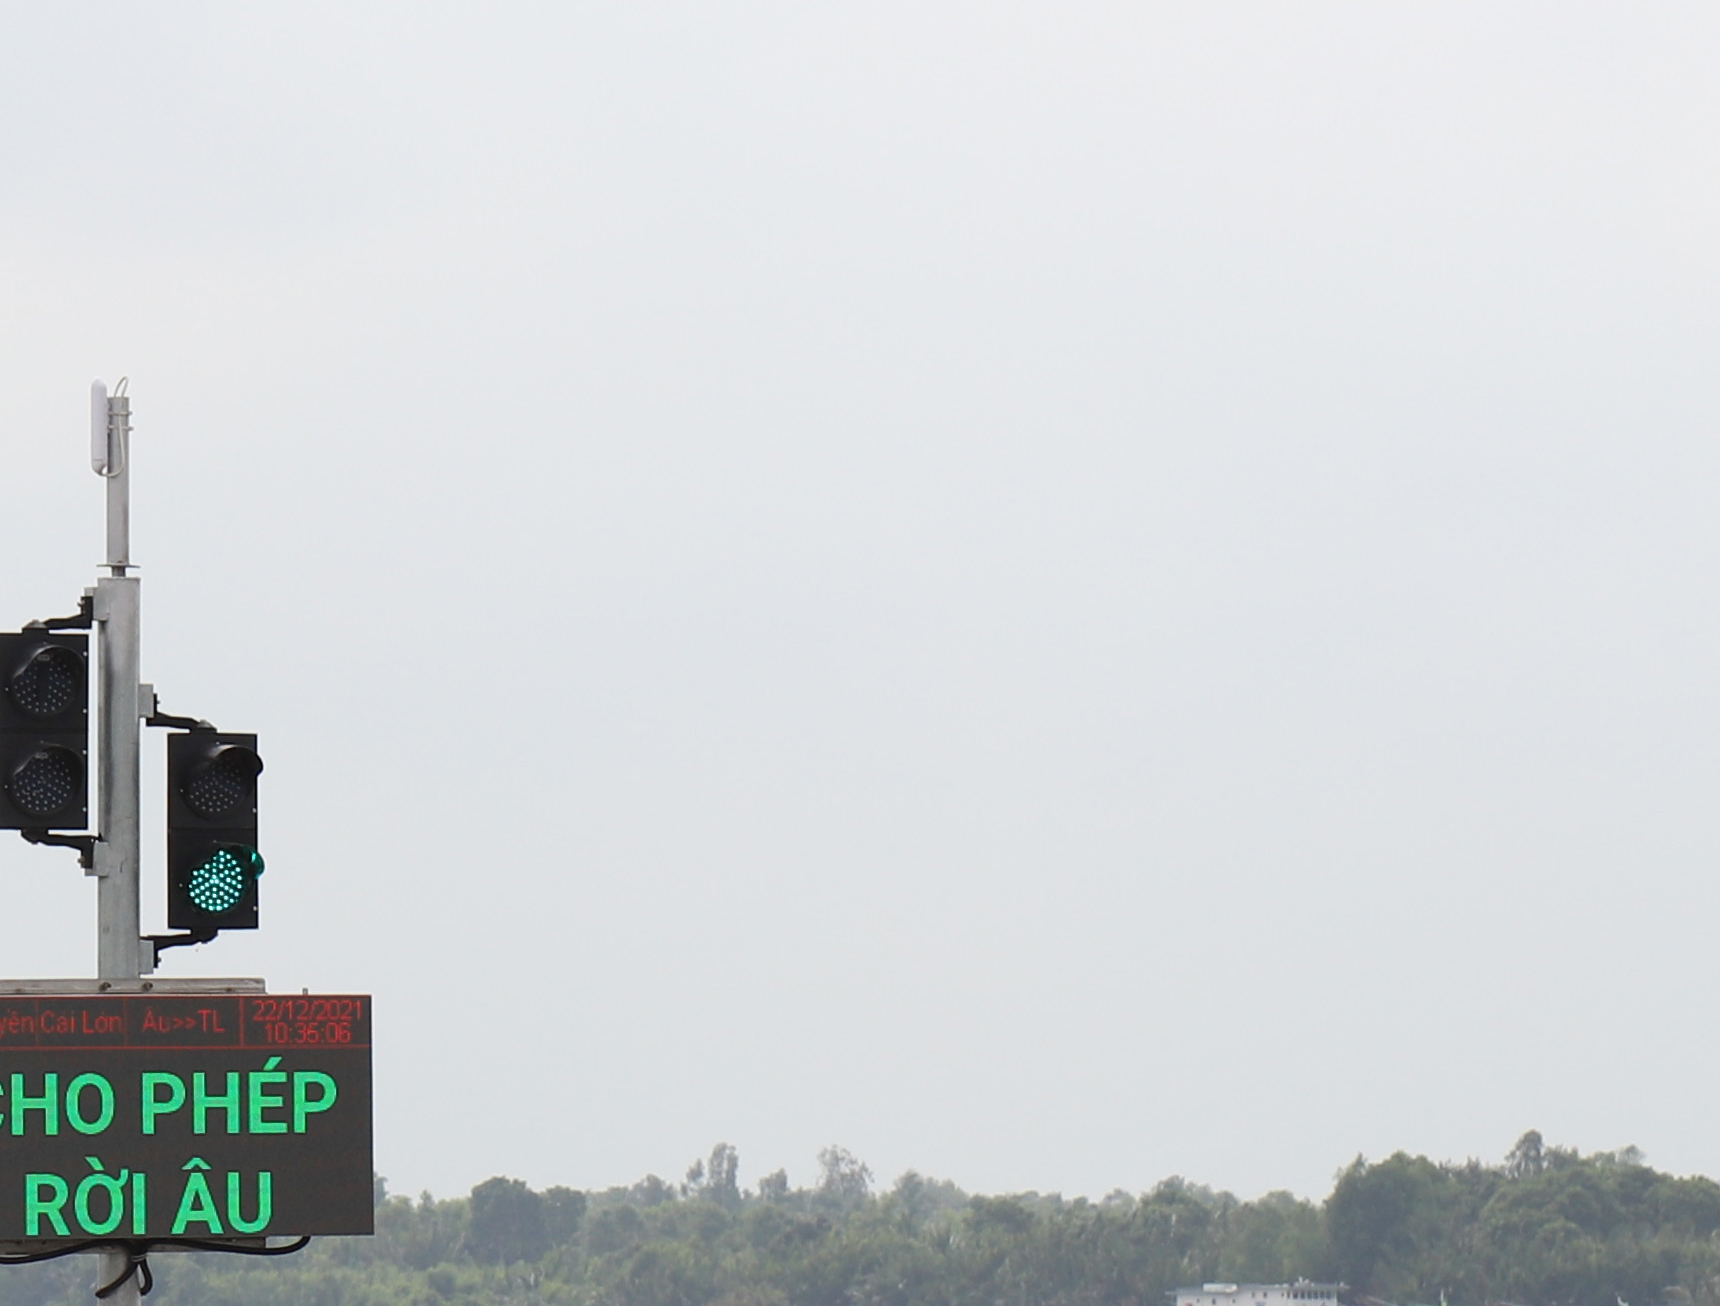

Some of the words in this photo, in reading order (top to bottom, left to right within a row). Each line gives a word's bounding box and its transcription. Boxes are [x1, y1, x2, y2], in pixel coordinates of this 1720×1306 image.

[253, 999, 363, 1020] 22/12/2021
[265, 1021, 352, 1043] 10:35:06
[141, 1056, 338, 1135] PHÉP
[25, 1157, 148, 1236] RỜI
[171, 1157, 274, 1235] ÂU
